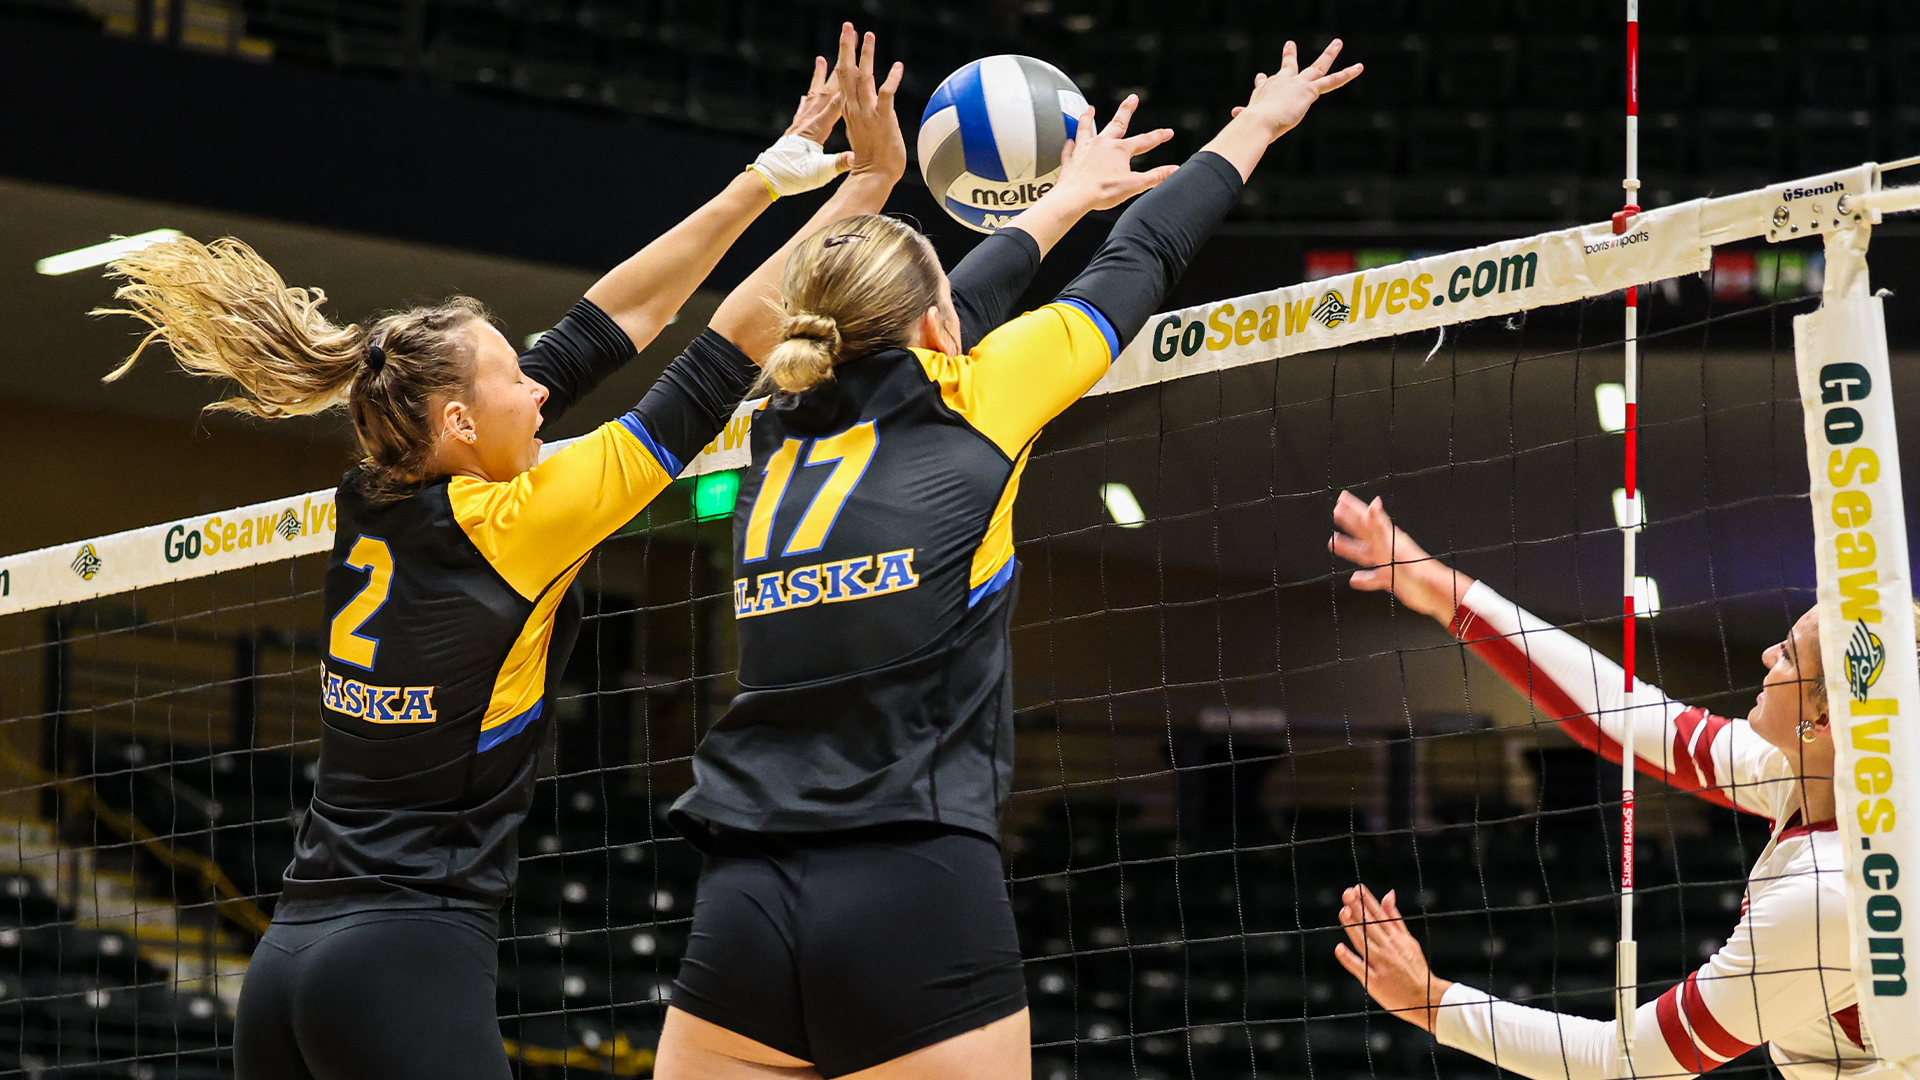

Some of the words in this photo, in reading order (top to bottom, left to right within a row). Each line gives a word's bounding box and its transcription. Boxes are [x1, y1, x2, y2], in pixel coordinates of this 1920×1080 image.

[972, 183, 1054, 205] molte
[1793, 181, 1845, 199] Senoh
[1584, 241, 1610, 255] ports
[743, 418, 880, 564] 17
[329, 533, 396, 672] 2
[734, 548, 920, 619] LASKA
[320, 659, 437, 724] ASKA
